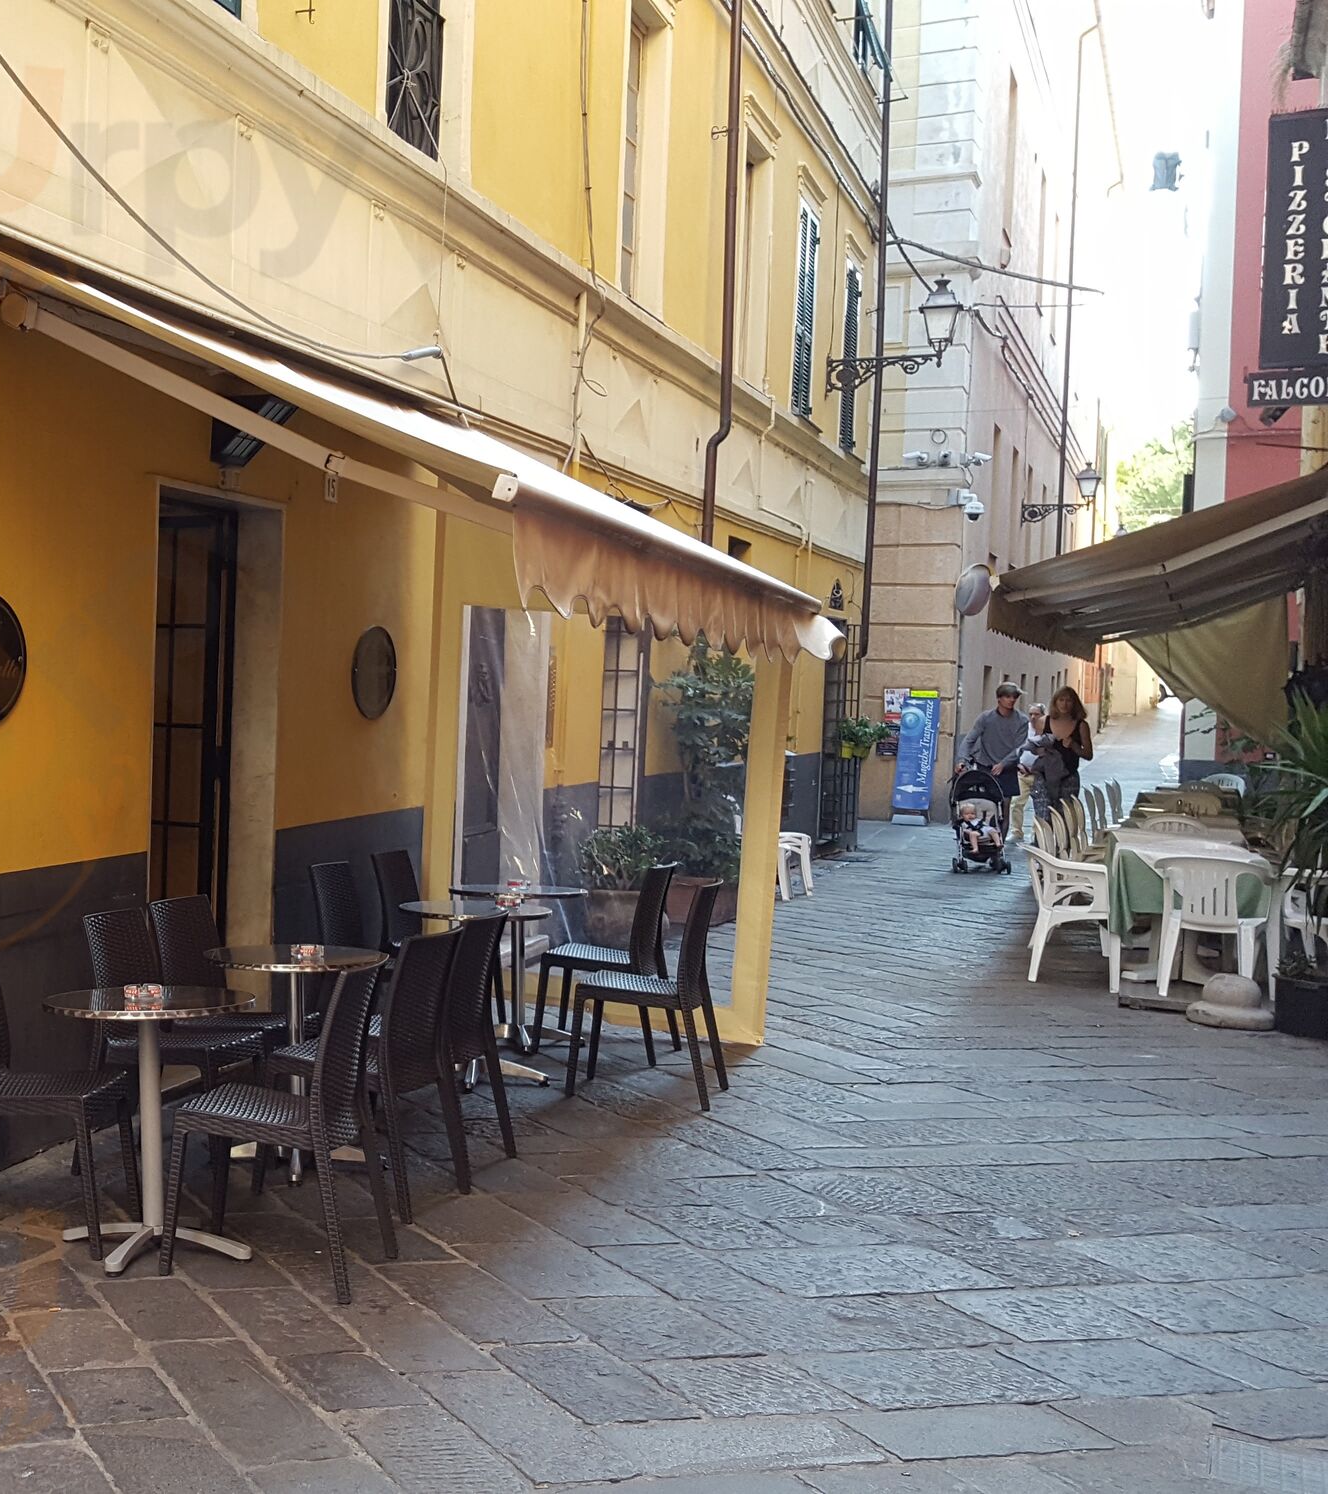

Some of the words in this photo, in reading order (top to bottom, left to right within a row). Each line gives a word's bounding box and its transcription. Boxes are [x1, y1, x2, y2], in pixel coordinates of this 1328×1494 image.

[1281, 140, 1310, 334] PIZZERIA
[1252, 376, 1328, 401] FALCO
[326, 477, 336, 498] 15
